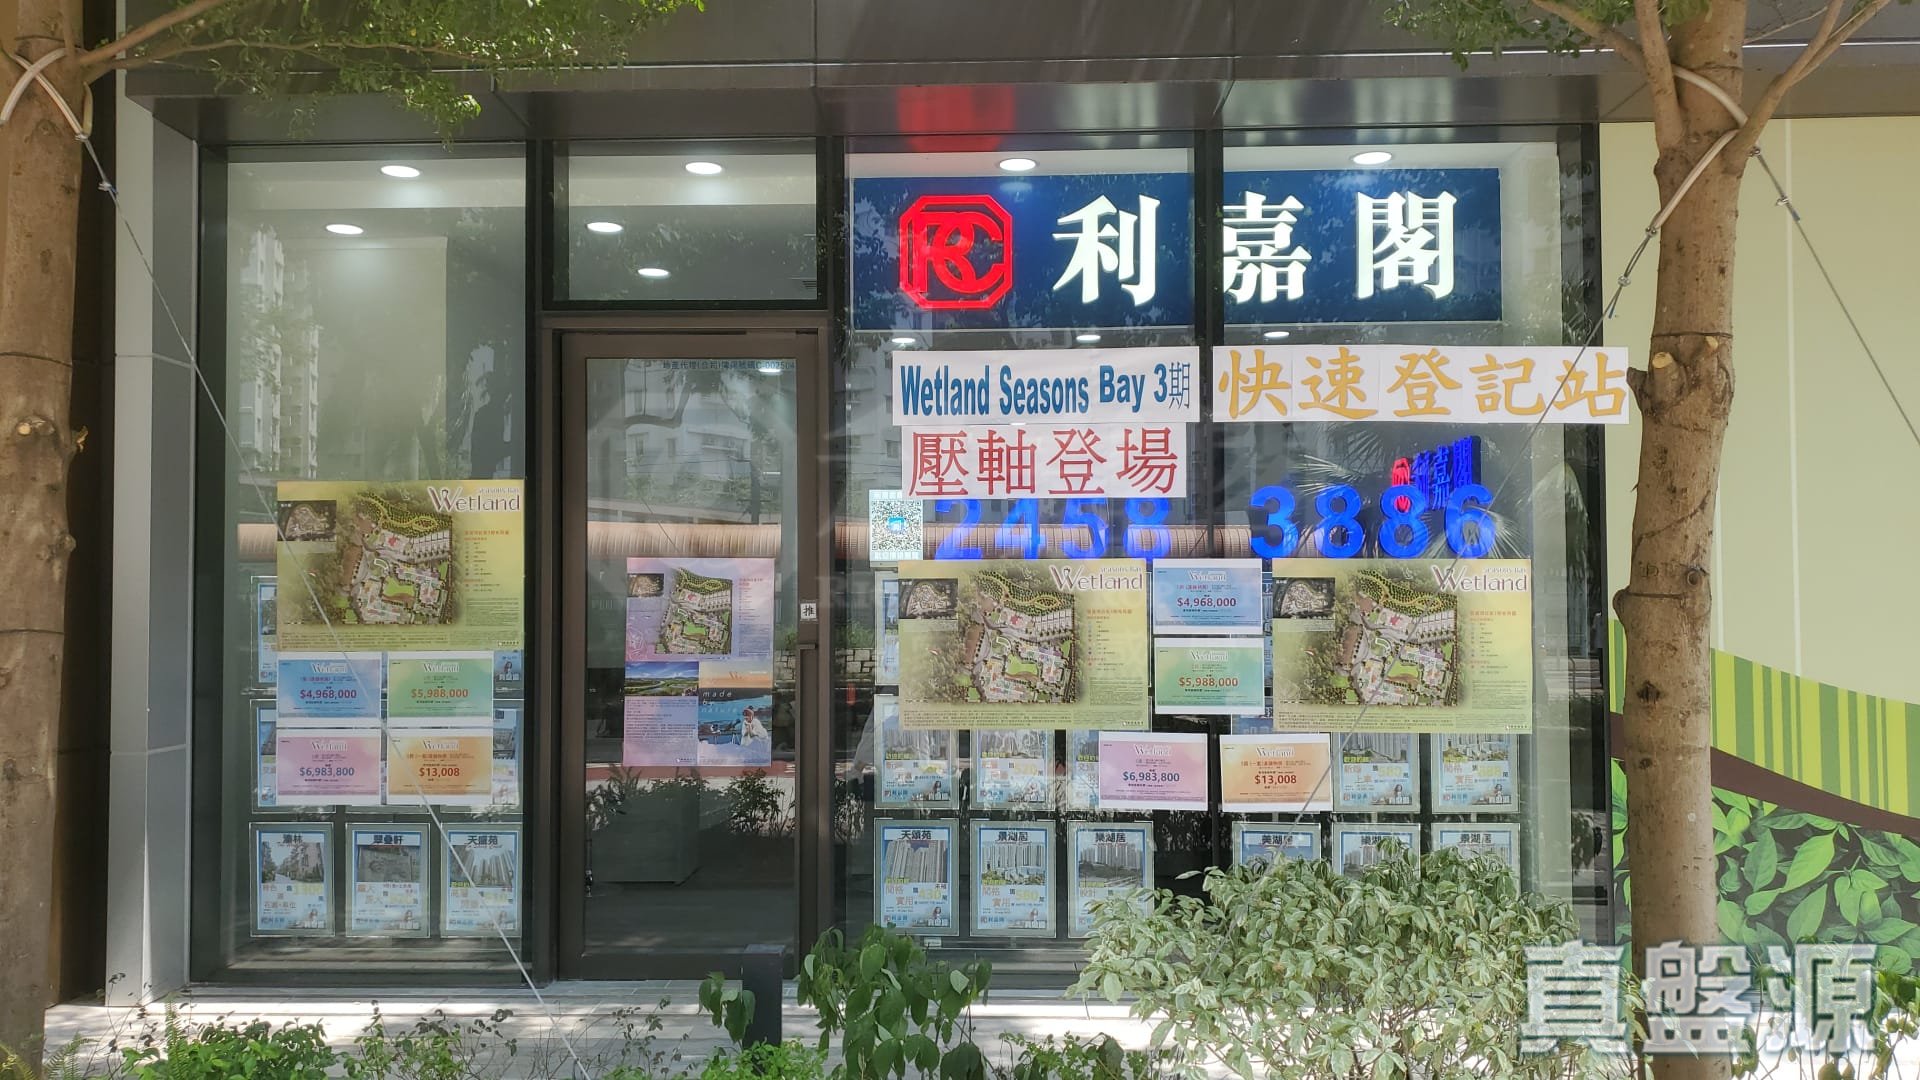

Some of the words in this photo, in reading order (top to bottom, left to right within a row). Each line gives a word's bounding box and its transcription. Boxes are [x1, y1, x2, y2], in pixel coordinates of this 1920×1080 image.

[1052, 192, 1458, 306] 利嘉閣
[901, 366, 990, 416] Wetland
[1000, 368, 1089, 415] Seasons
[1099, 364, 1145, 414] Bay
[1153, 361, 1190, 411] 3期
[1218, 347, 1628, 421] 快速登記站
[909, 427, 1178, 497] 壓軸登場
[428, 487, 521, 511] Wetland
[932, 497, 1172, 560] 2458
[1249, 484, 1496, 559] 3886
[1050, 565, 1143, 590] Wetland
[1432, 565, 1528, 591] Wetland
[1177, 597, 1237, 608] $4,968,000
[802, 604, 815, 616] 推
[1179, 677, 1239, 687] $5,988,000
[300, 689, 357, 700] $4,968,000
[411, 688, 469, 699] $5,988,000
[300, 766, 355, 777] $6,983,800
[418, 766, 460, 778] $13,008
[1123, 771, 1180, 782] $6,983,800
[1254, 775, 1297, 785] $13,008
